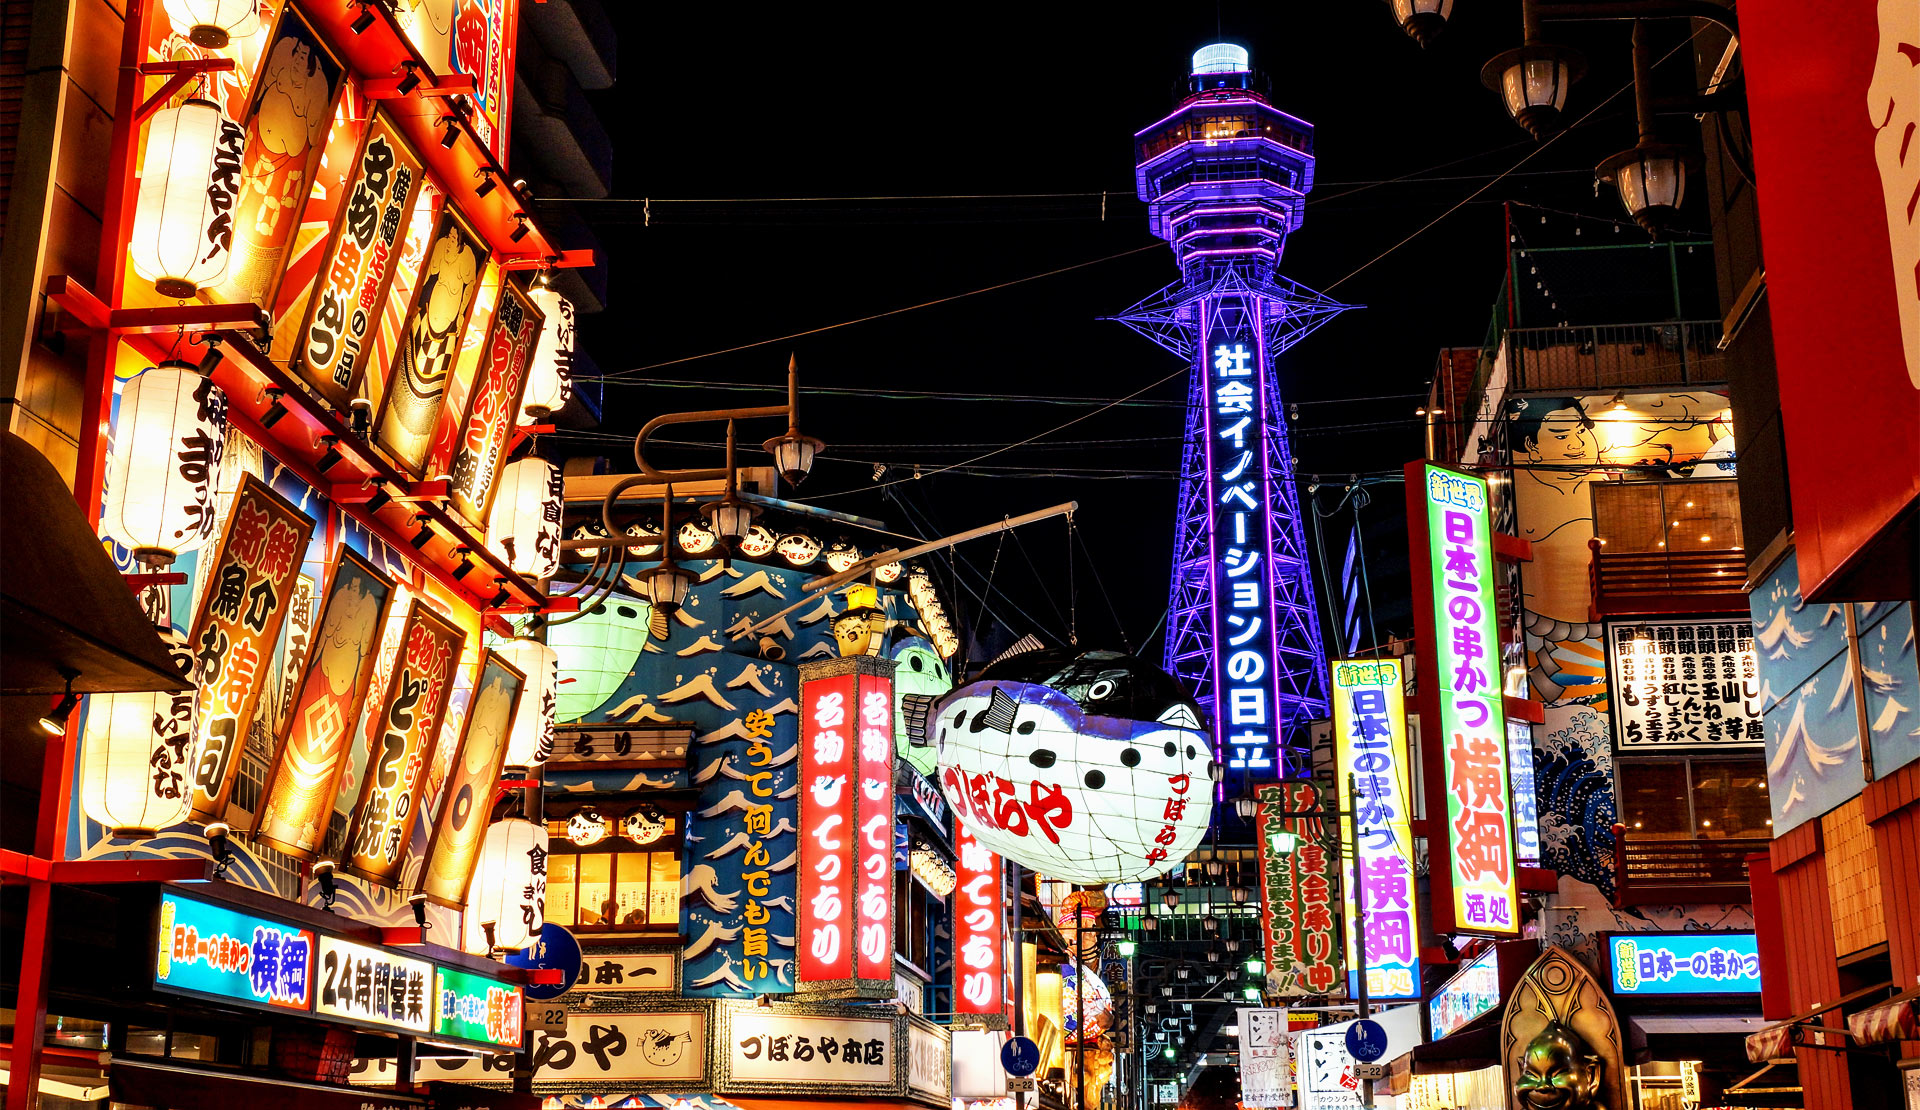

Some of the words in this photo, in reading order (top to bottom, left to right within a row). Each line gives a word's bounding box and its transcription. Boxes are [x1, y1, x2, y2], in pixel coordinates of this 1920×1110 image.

[309, 136, 395, 367] 名物串かつ
[1430, 472, 1483, 508] 新世界
[1214, 345, 1270, 768] 社会イノベーションの日立
[1443, 511, 1488, 728] 日本一の串かつ
[1617, 628, 1635, 656] 前頭
[1657, 626, 1677, 655] 前頭
[1677, 626, 1697, 655] 前頭
[1696, 626, 1716, 654] 前頭
[1716, 625, 1736, 653] 前頭
[1736, 625, 1755, 653] 前頭
[1338, 664, 1396, 687] 新世界
[813, 692, 844, 764] 名物
[862, 692, 889, 763] 名物
[1622, 684, 1643, 742] もち
[1643, 683, 1664, 742] うずら玉子
[1662, 683, 1685, 741] 紅しょうが
[1681, 683, 1703, 741] にんにく
[1702, 682, 1724, 741] 玉ねぎ
[1722, 681, 1744, 740] 山芋
[1742, 681, 1764, 740] しし唐
[385, 642, 451, 863] 大阪下町の味
[1350, 689, 1397, 850] 日本一の串かつ
[944, 764, 1072, 844] づぼらや
[1146, 772, 1191, 866] づぼらや
[1450, 734, 1508, 884] 横綱
[743, 708, 776, 981] 安うて何んでも旨い
[811, 814, 842, 964] てっちり
[861, 814, 889, 963] てっちり
[961, 826, 993, 1006] 味てっちり
[1350, 857, 1410, 966] 横綱
[1466, 892, 1510, 924] 酒処
[173, 925, 249, 973] 日本一の串かつ
[250, 929, 309, 1002] 横綱
[322, 950, 423, 1023] 24時間営業
[1617, 941, 1637, 989] 新世界
[1639, 949, 1760, 980] 日本一の串かつ
[486, 986, 521, 1043] 横綱
[740, 1033, 884, 1066] づぼらや本店
[1355, 1067, 1381, 1076] 9-22
[1009, 1081, 1033, 1089] 9-22
